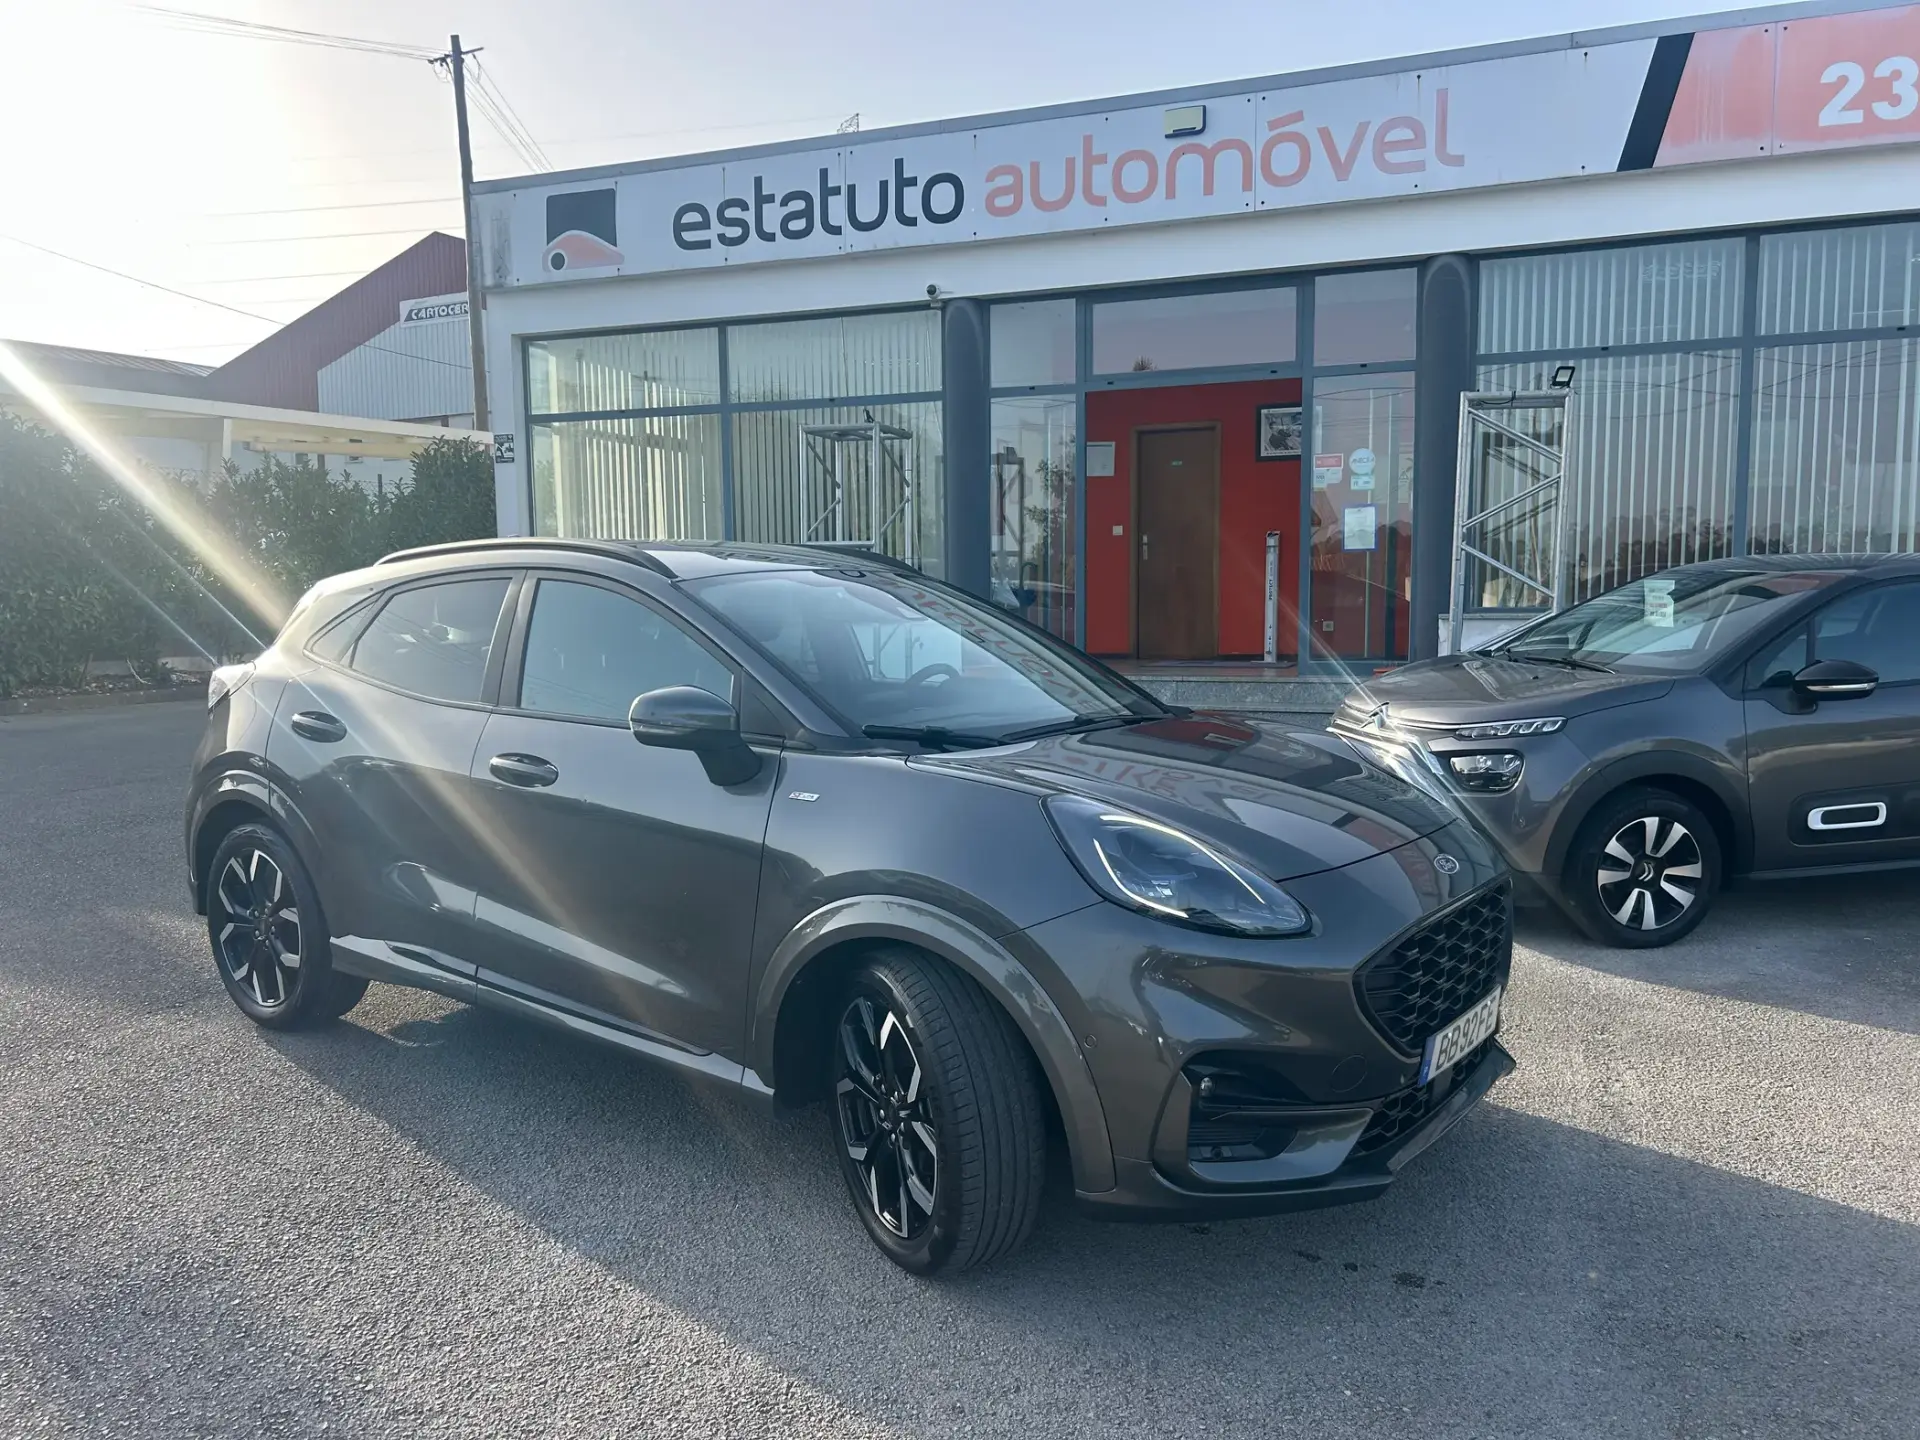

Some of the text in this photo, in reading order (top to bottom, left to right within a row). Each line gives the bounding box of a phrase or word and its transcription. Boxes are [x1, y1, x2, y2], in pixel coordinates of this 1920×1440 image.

[1818, 56, 1919, 127] 23
[672, 87, 1465, 251] estatuto automóvel
